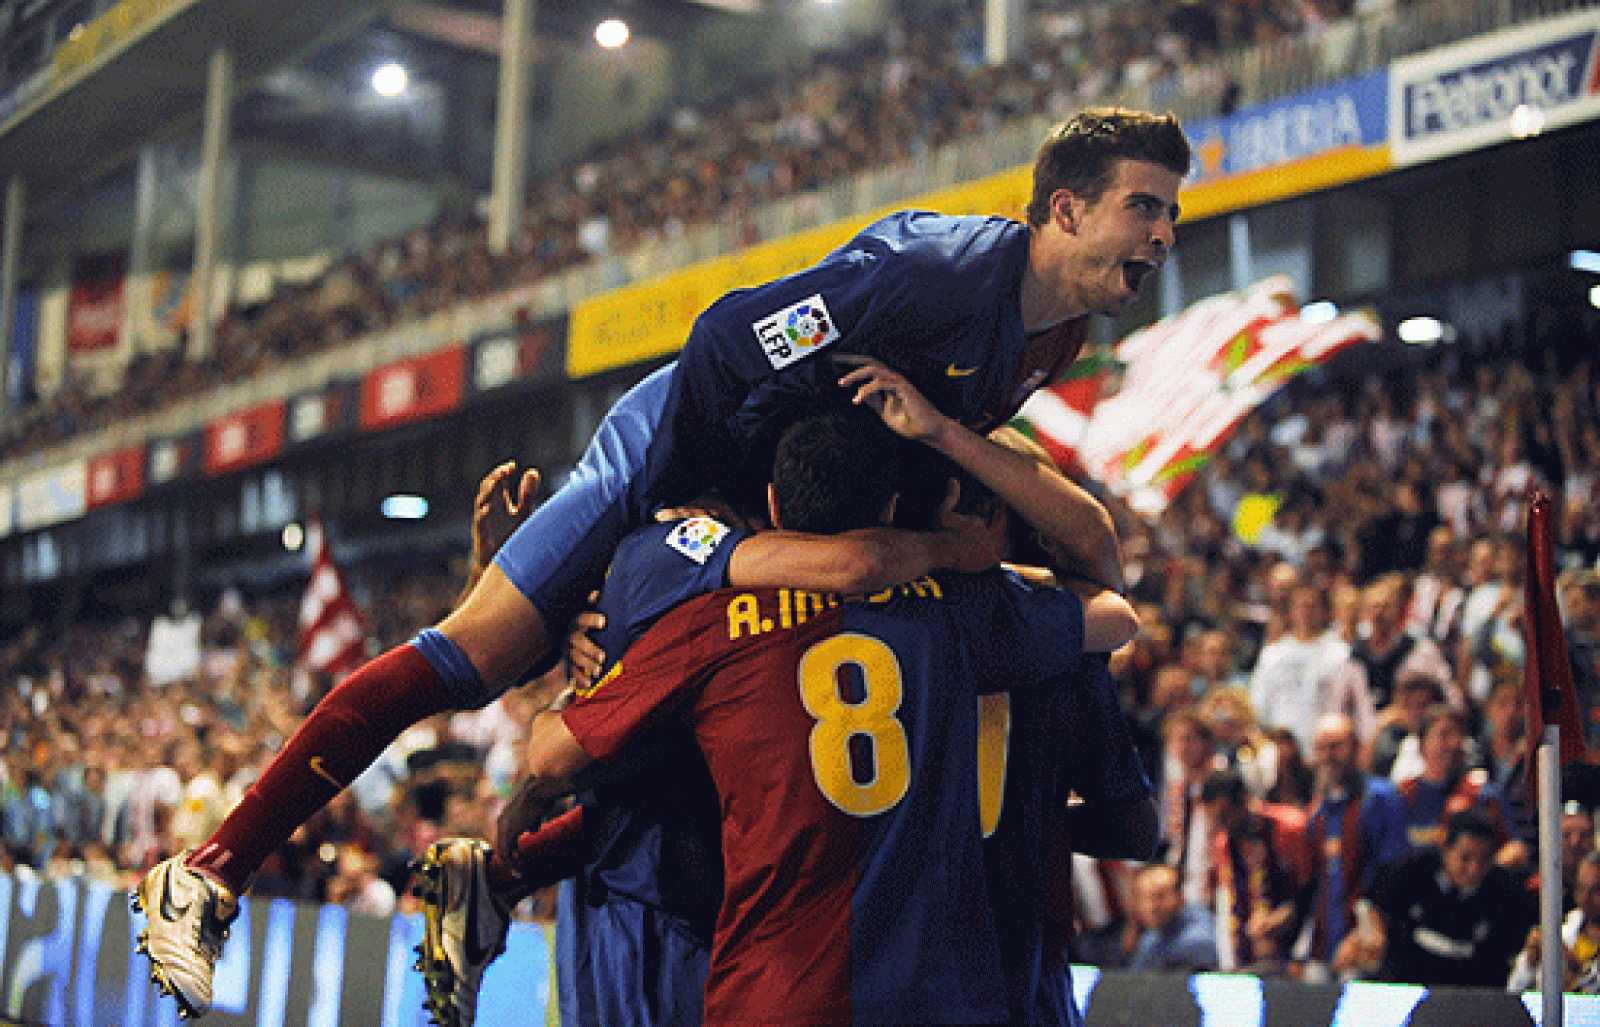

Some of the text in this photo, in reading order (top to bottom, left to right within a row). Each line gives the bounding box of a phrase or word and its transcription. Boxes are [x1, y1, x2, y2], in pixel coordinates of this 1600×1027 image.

[1410, 53, 1576, 136] Petronor
[759, 321, 792, 358] LFP
[799, 633, 912, 817] 8
